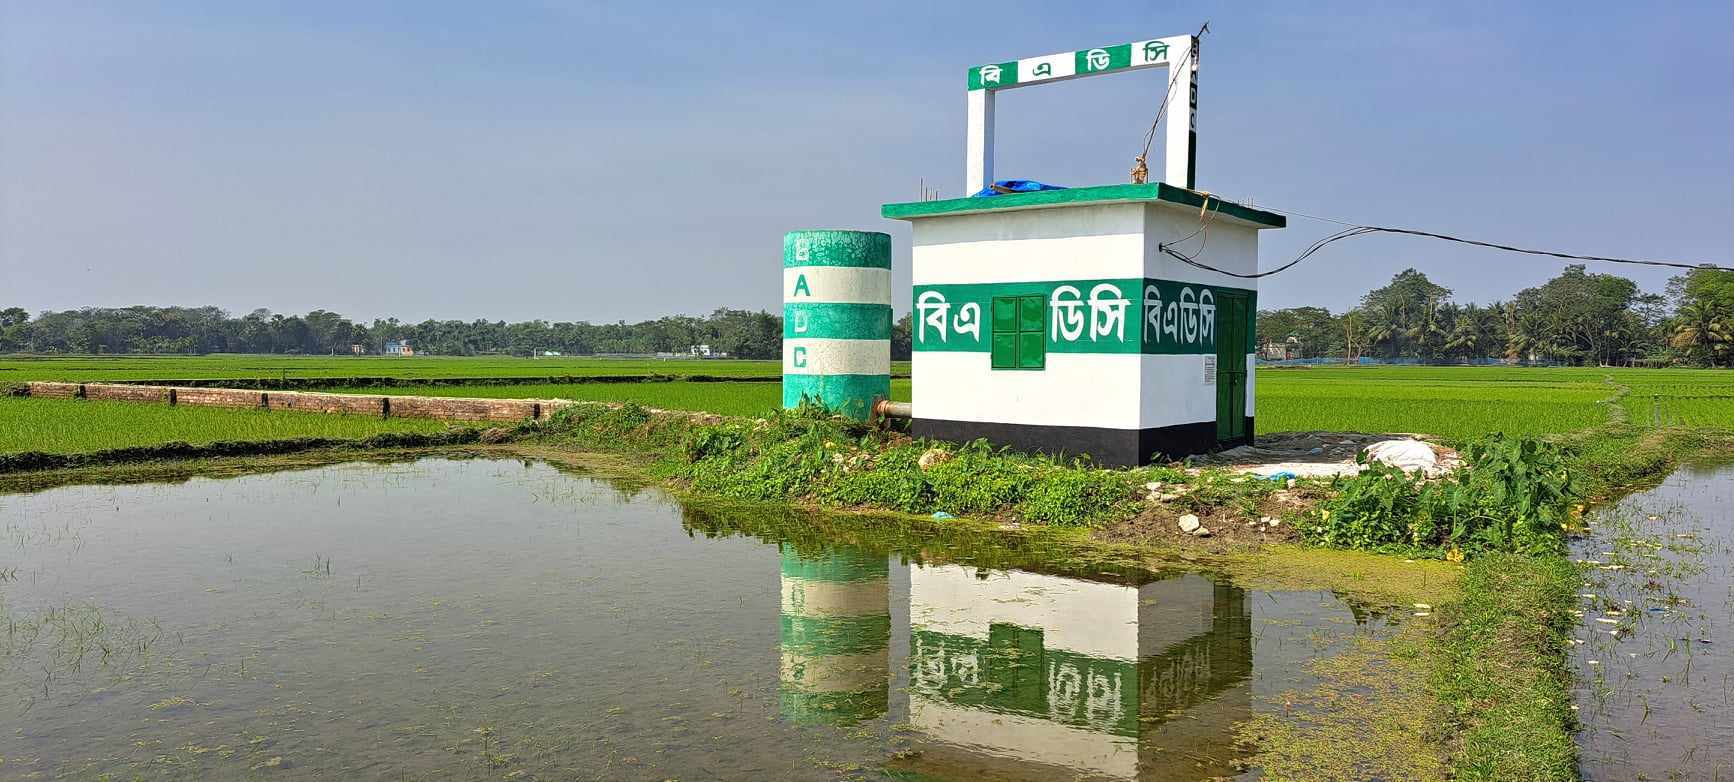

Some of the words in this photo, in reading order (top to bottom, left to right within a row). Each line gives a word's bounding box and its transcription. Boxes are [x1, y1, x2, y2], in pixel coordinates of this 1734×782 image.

[916, 291, 981, 343] বিএ
[1050, 284, 1132, 343] ডিসি
[1143, 284, 1216, 347] বিএডিসি
